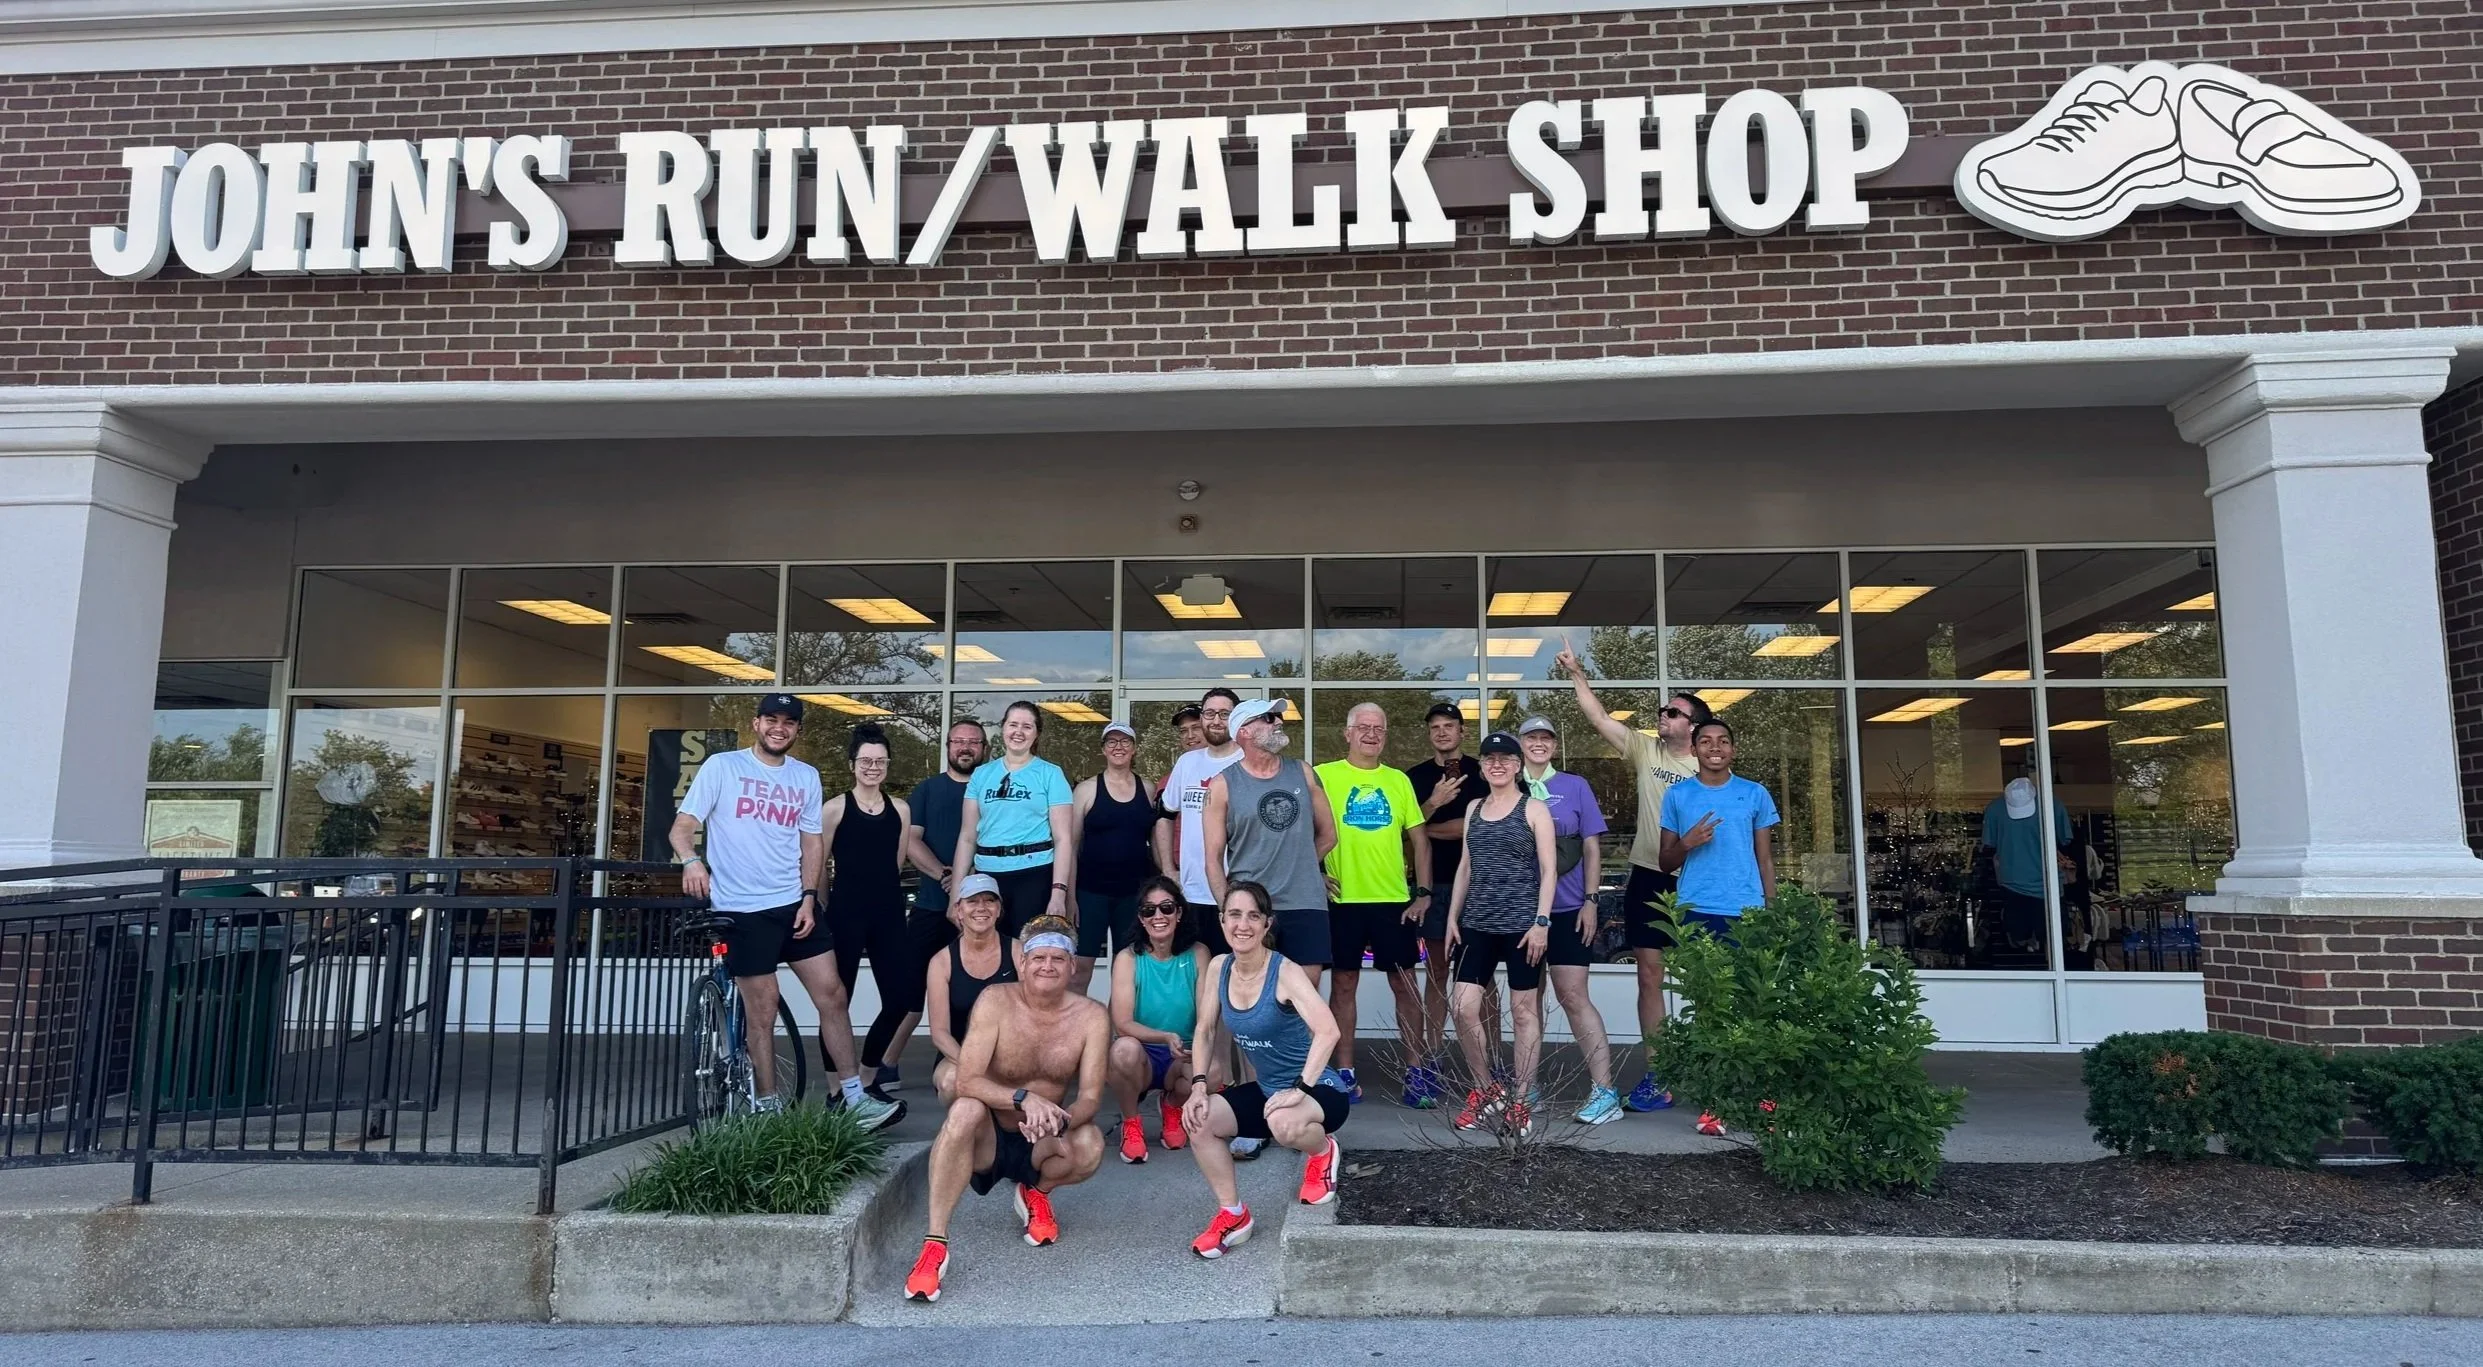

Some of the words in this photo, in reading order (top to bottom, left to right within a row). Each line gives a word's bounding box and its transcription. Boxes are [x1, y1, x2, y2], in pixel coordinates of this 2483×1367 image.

[90, 134, 570, 281] JOHN'S
[613, 105, 1457, 268] RUN/WALK
[1506, 86, 1910, 244] SHOP
[738, 776, 806, 807] TEAM
[984, 787, 1032, 800] RuLex
